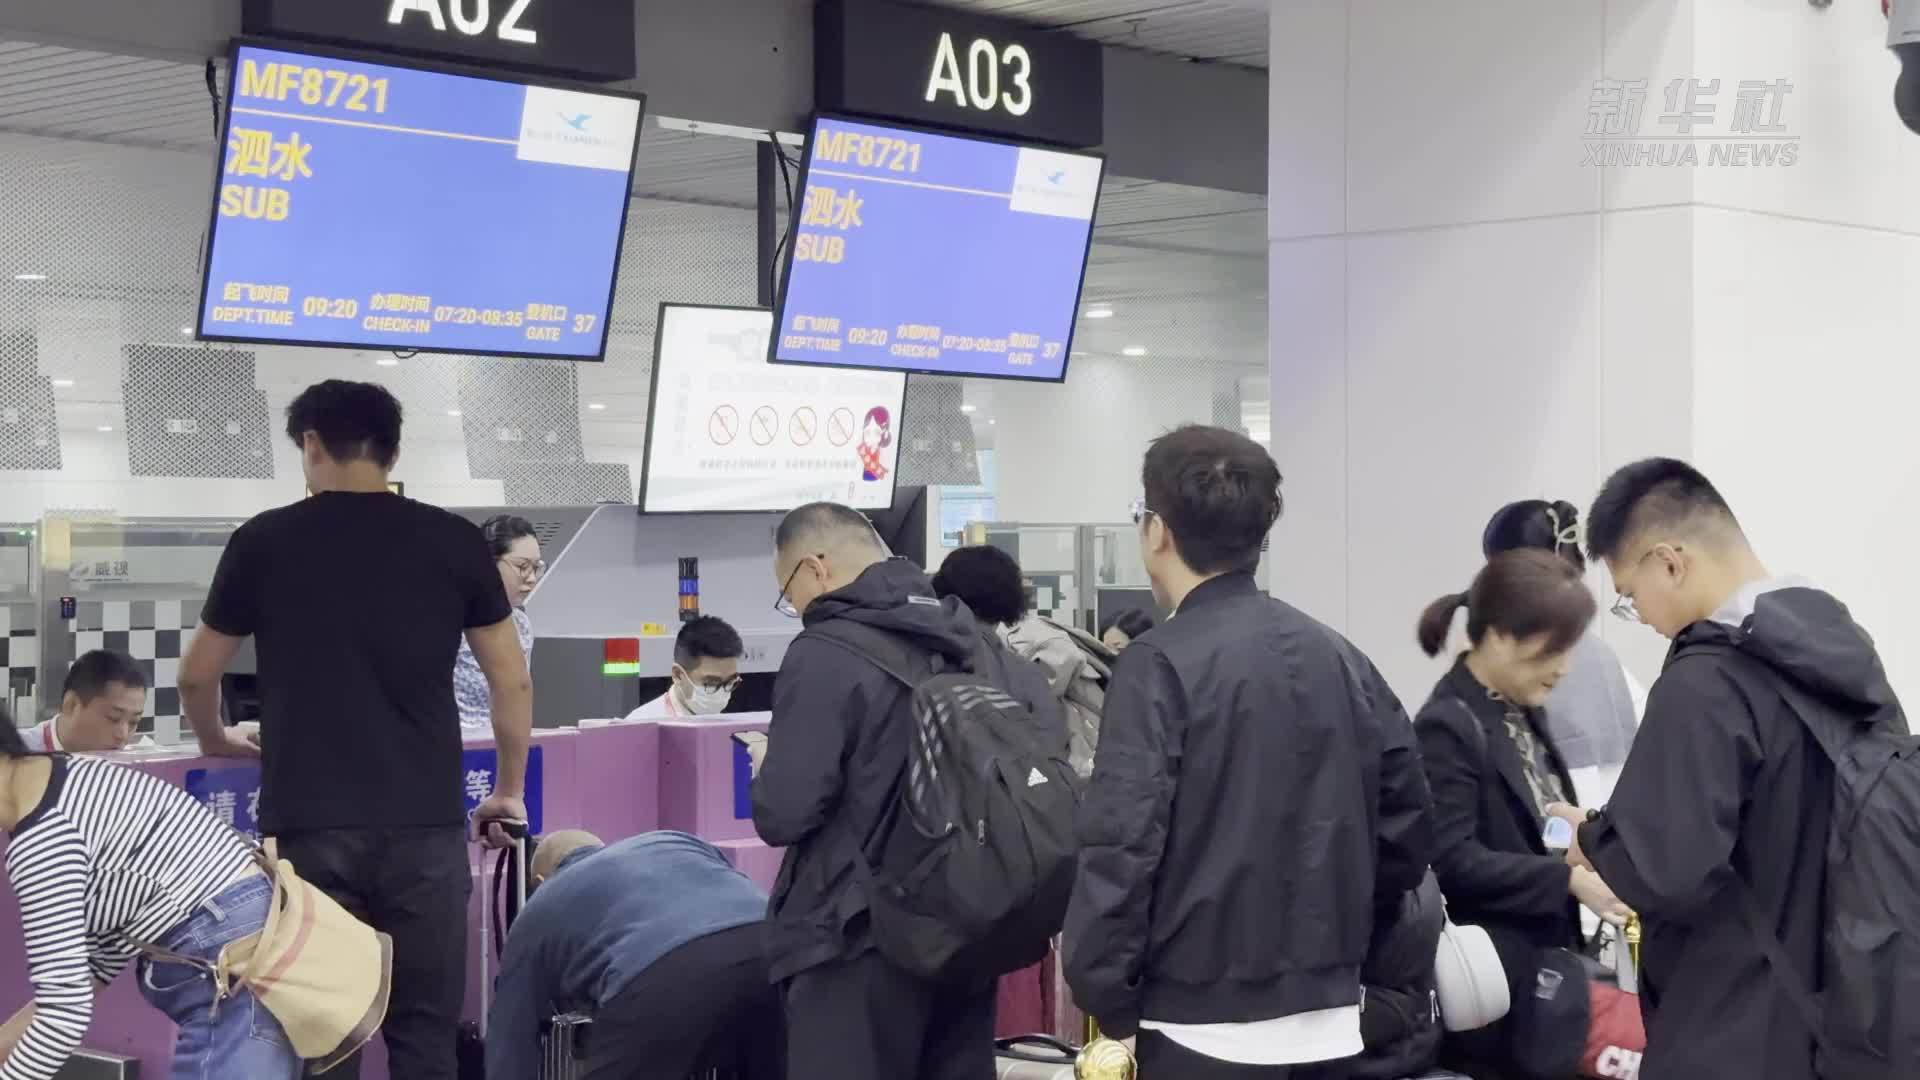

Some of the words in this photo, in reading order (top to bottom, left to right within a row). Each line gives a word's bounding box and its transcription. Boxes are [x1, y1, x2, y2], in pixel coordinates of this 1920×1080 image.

[239, 60, 389, 113] MF8721
[925, 32, 1032, 116] A03
[226, 127, 313, 181] 泗水
[816, 129, 920, 172] MF8721
[220, 184, 289, 222] SUB
[802, 185, 864, 229] 泗水
[796, 234, 845, 264] SUB
[304, 297, 358, 318] 09:20
[434, 305, 523, 327] 07:20-08:35
[364, 315, 430, 333] CHECK-IN
[527, 326, 561, 341] GATE
[573, 314, 596, 333] 37
[847, 327, 888, 346] 09:20
[1042, 342, 1060, 359] 37
